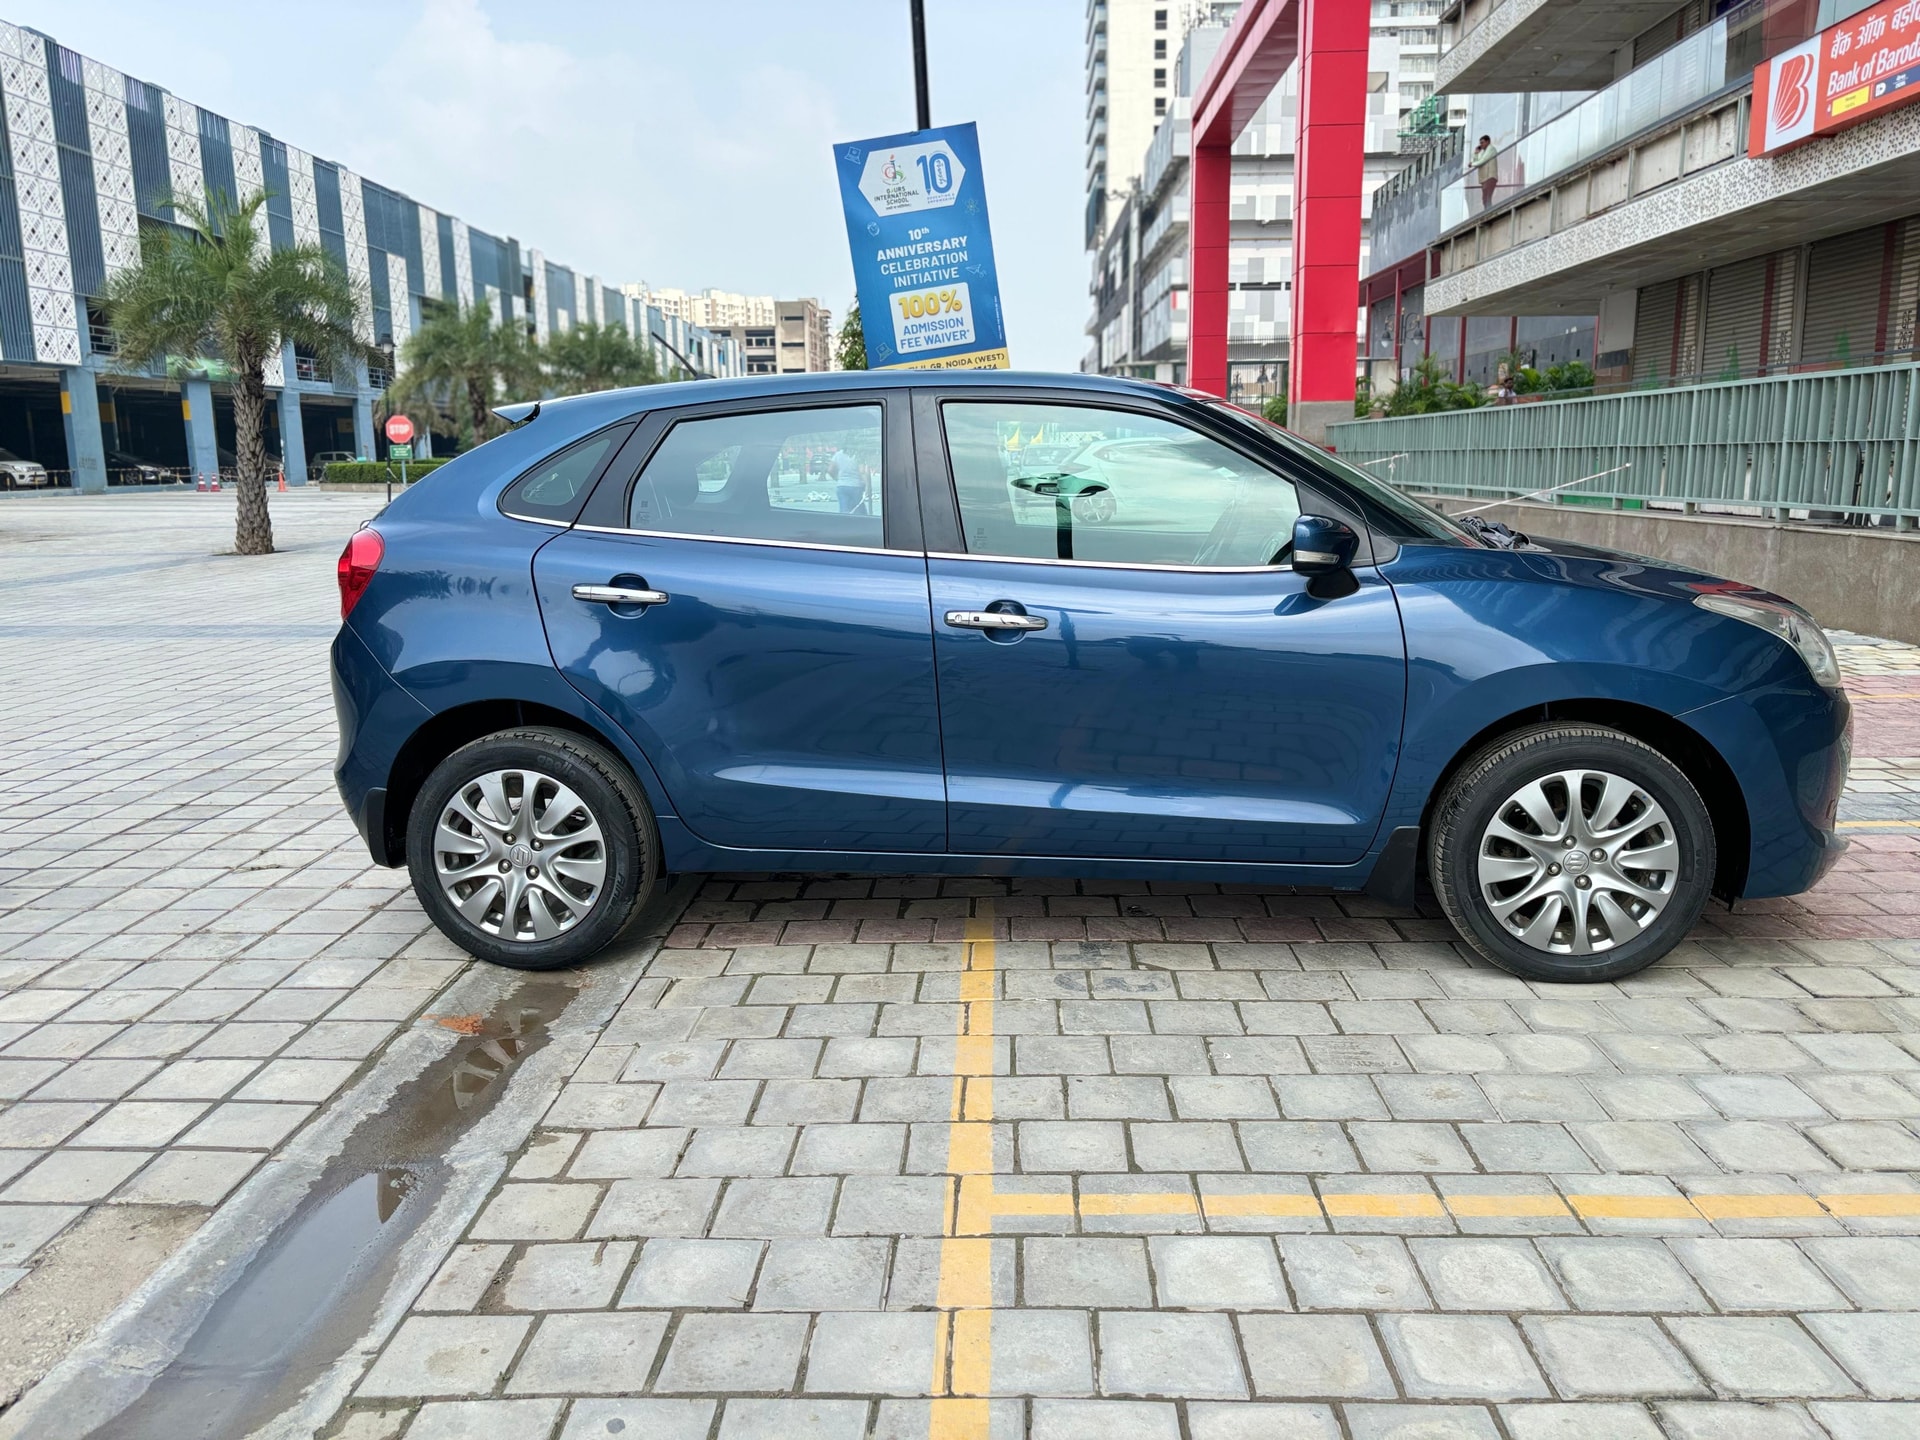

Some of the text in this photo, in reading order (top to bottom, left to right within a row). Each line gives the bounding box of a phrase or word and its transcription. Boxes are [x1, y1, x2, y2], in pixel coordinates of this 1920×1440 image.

[1826, 60, 1861, 97] Bank
[1860, 51, 1878, 82] of
[916, 152, 953, 195] 10
[873, 189, 920, 202] INTERNATIONAL
[886, 197, 909, 206] SCHOOL
[908, 226, 930, 241] 10th
[877, 235, 968, 262] ANNIVERSARY
[880, 250, 969, 276] CELEBRATION
[893, 267, 960, 288] INITIATIVE
[898, 289, 963, 320] 100%
[903, 317, 965, 336] ADMISSION
[900, 336, 922, 349] FEE
[945, 358, 973, 369] NOIDA
[974, 353, 1005, 365] (WEST)
[389, 424, 410, 434] STOP
